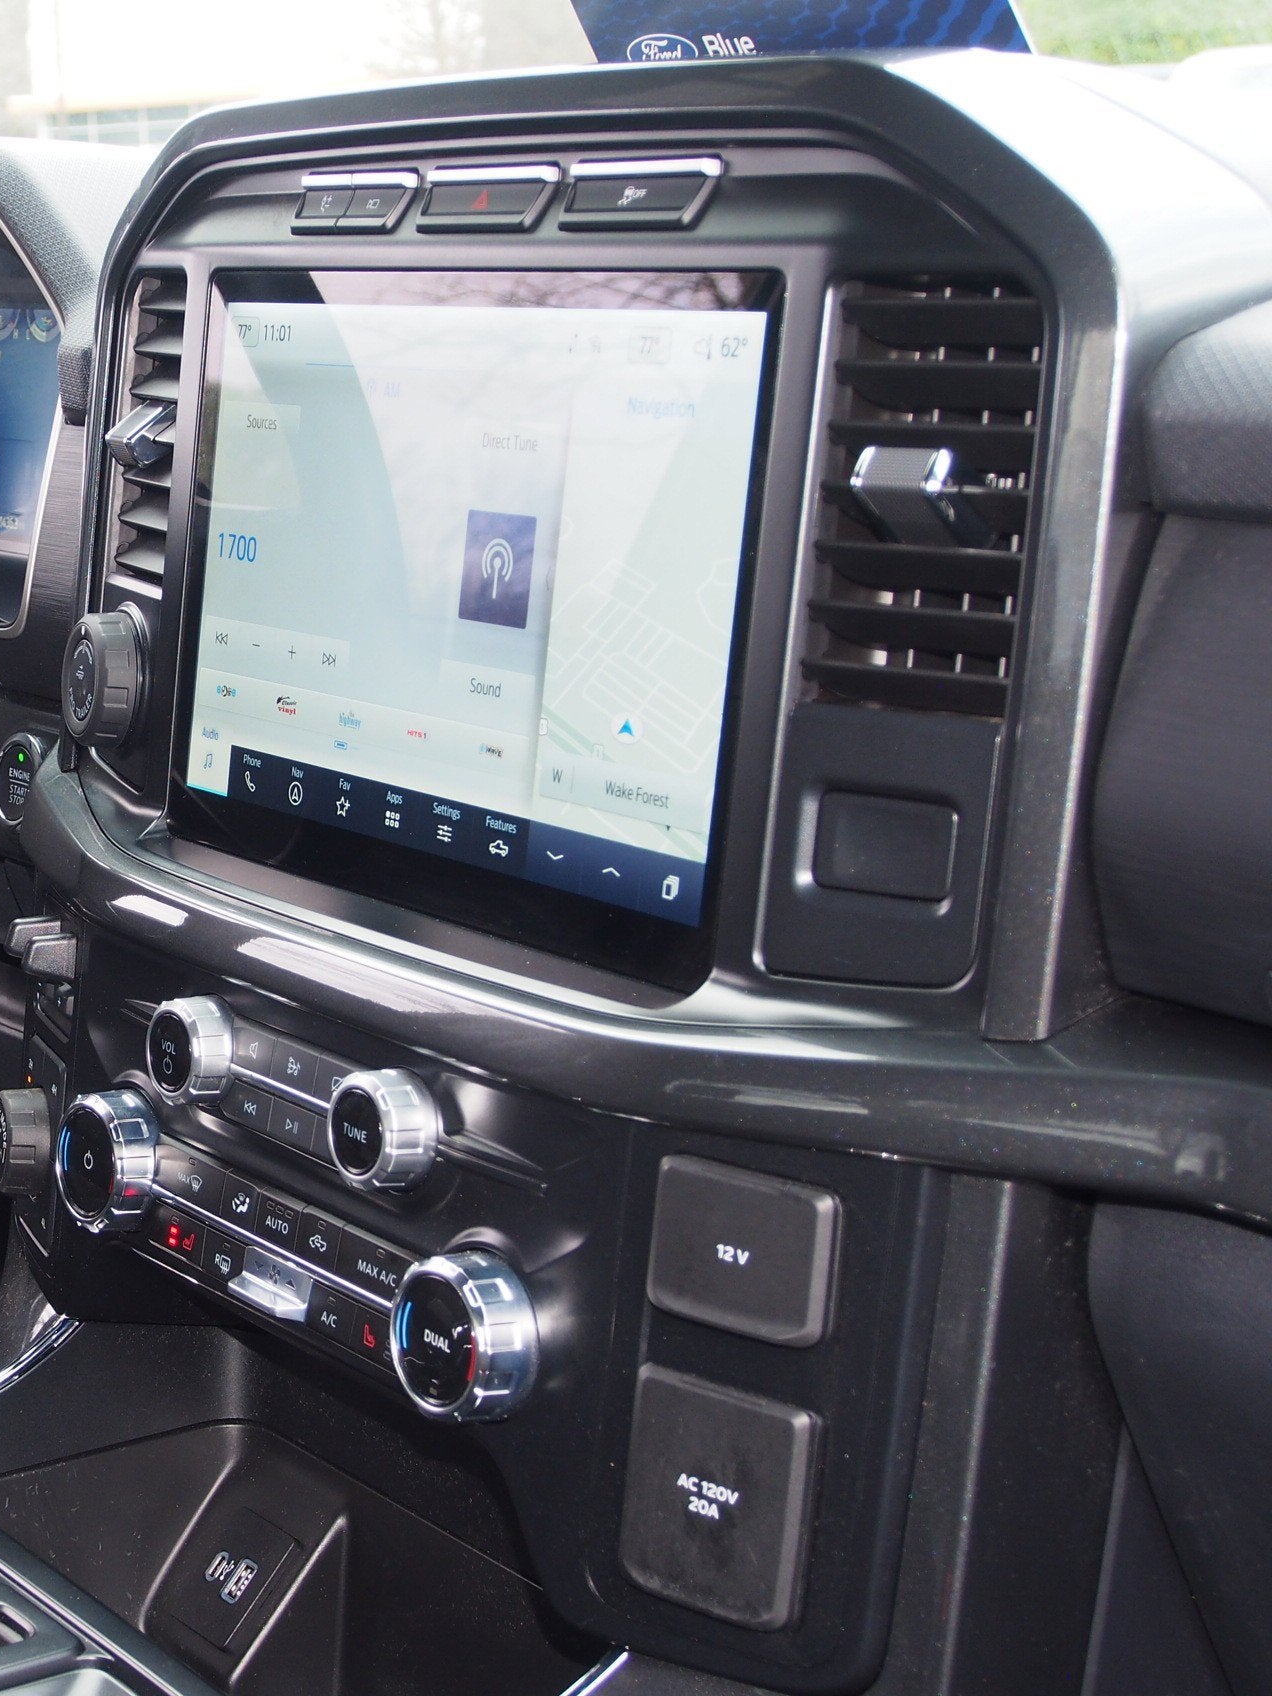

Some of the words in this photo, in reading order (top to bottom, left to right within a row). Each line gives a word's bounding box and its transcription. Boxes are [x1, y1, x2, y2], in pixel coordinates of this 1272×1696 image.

[641, 39, 682, 61] Ford
[701, 33, 756, 57] Blue
[263, 323, 292, 343] 11:01
[627, 396, 696, 419] Navigation
[246, 414, 277, 430] Sources
[482, 432, 511, 450] Direct
[514, 434, 539, 451] Tune
[218, 532, 257, 563] 1700
[469, 677, 501, 698] Sound
[201, 726, 219, 741] Audio
[243, 754, 261, 768] Phone
[9, 768, 30, 782] ENGINE
[291, 766, 304, 779] Nav
[552, 768, 563, 783] W
[9, 784, 29, 797] START
[339, 778, 351, 791] Fav
[8, 794, 24, 806] STOP
[386, 791, 403, 805] Apps
[605, 780, 634, 801] Wake
[636, 787, 669, 809] Forest
[432, 802, 461, 820] Settings
[485, 815, 517, 834] Features
[161, 1039, 176, 1055] VOL
[343, 1121, 367, 1144] TUNE
[265, 1215, 289, 1235] AUTO
[357, 1259, 378, 1278] MAX
[379, 1267, 397, 1288] A/C
[320, 1310, 337, 1329] A/C
[423, 1328, 451, 1353] DUAL
[677, 1472, 699, 1493] AC
[701, 1479, 739, 1506] 120V
[688, 1495, 720, 1520] 20A
